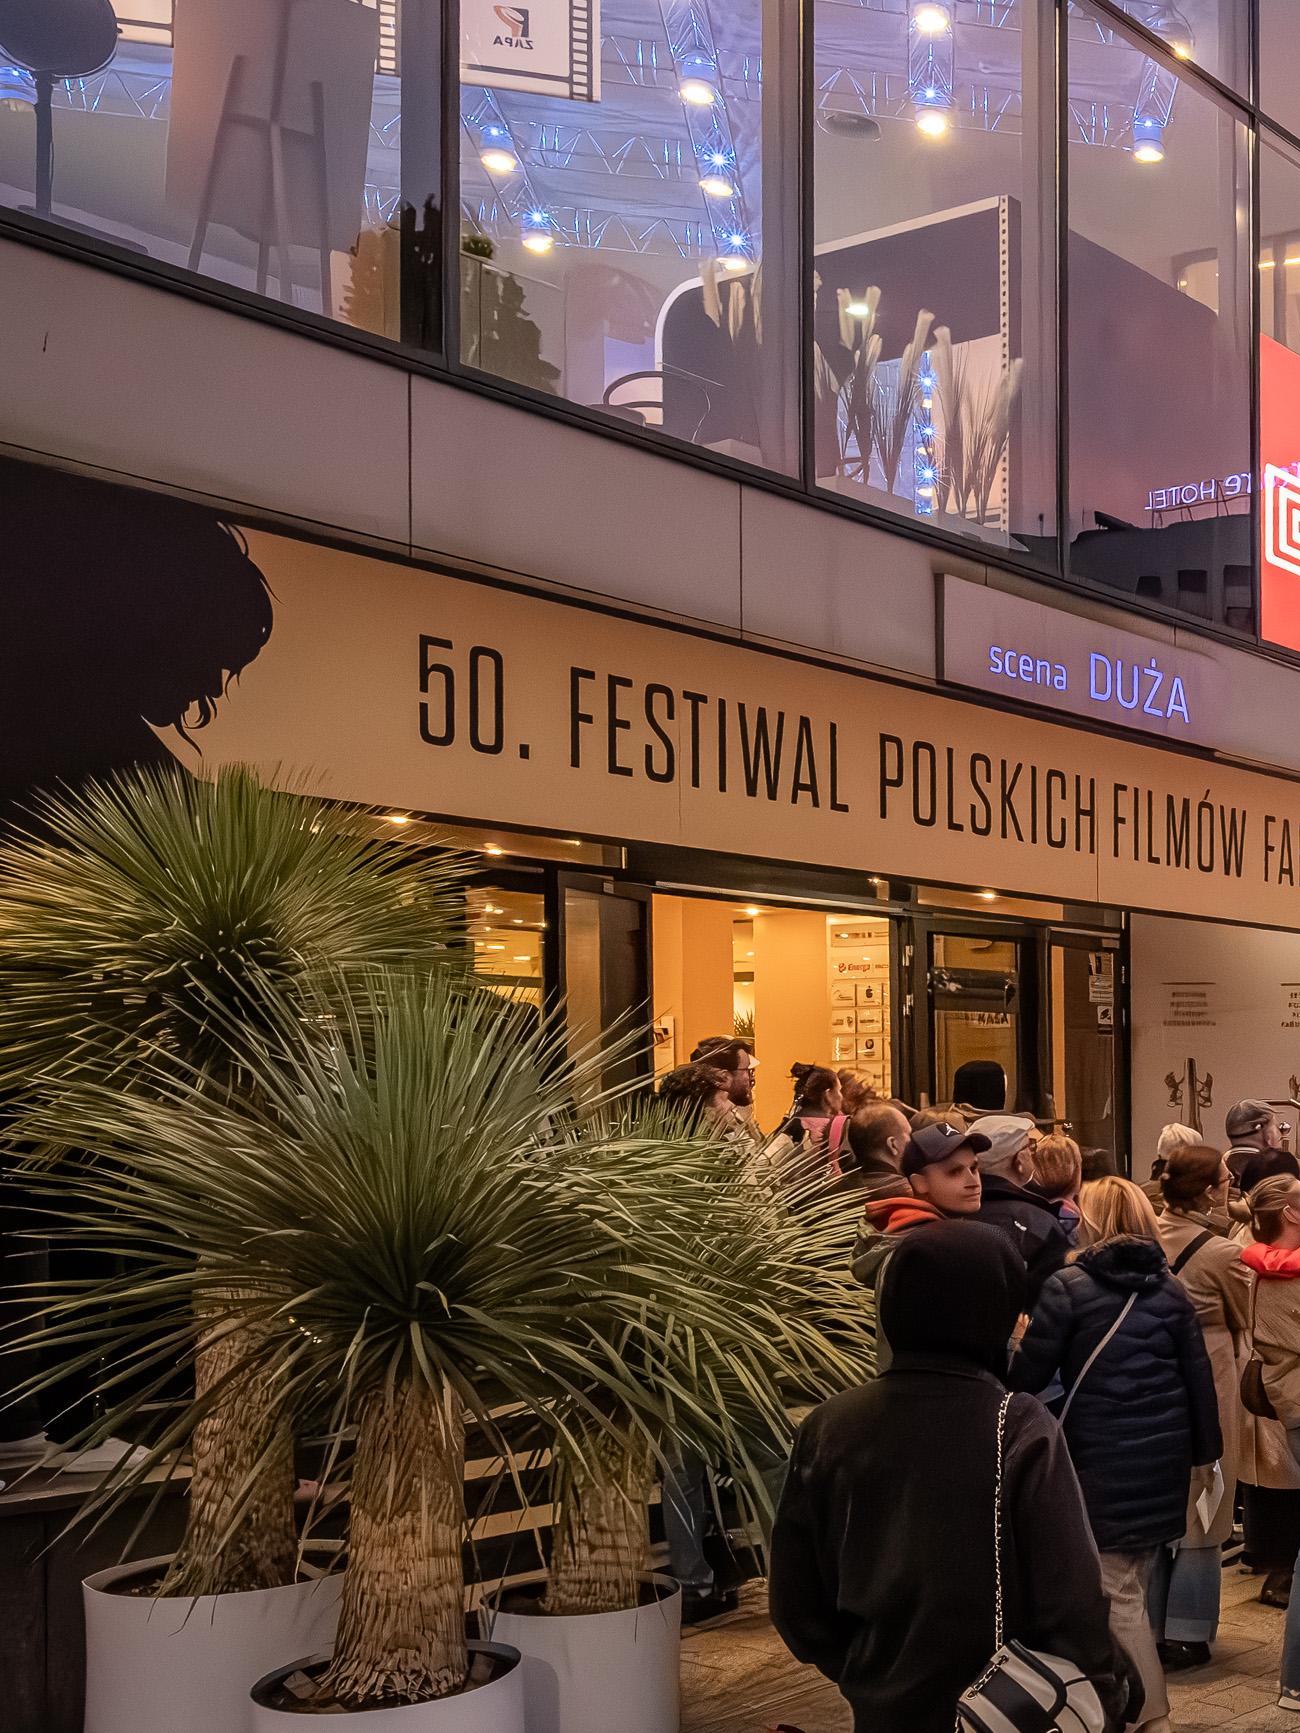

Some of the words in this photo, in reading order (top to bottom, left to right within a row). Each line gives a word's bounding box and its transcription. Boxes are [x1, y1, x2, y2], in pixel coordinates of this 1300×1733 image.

[418, 633, 530, 760] 50.
[570, 666, 849, 813] FESTIWAL
[879, 733, 1098, 855] POLSKICH
[1113, 781, 1247, 878] FILMÓW
[988, 645, 1068, 693] scena
[1089, 653, 1190, 724] DUŻA
